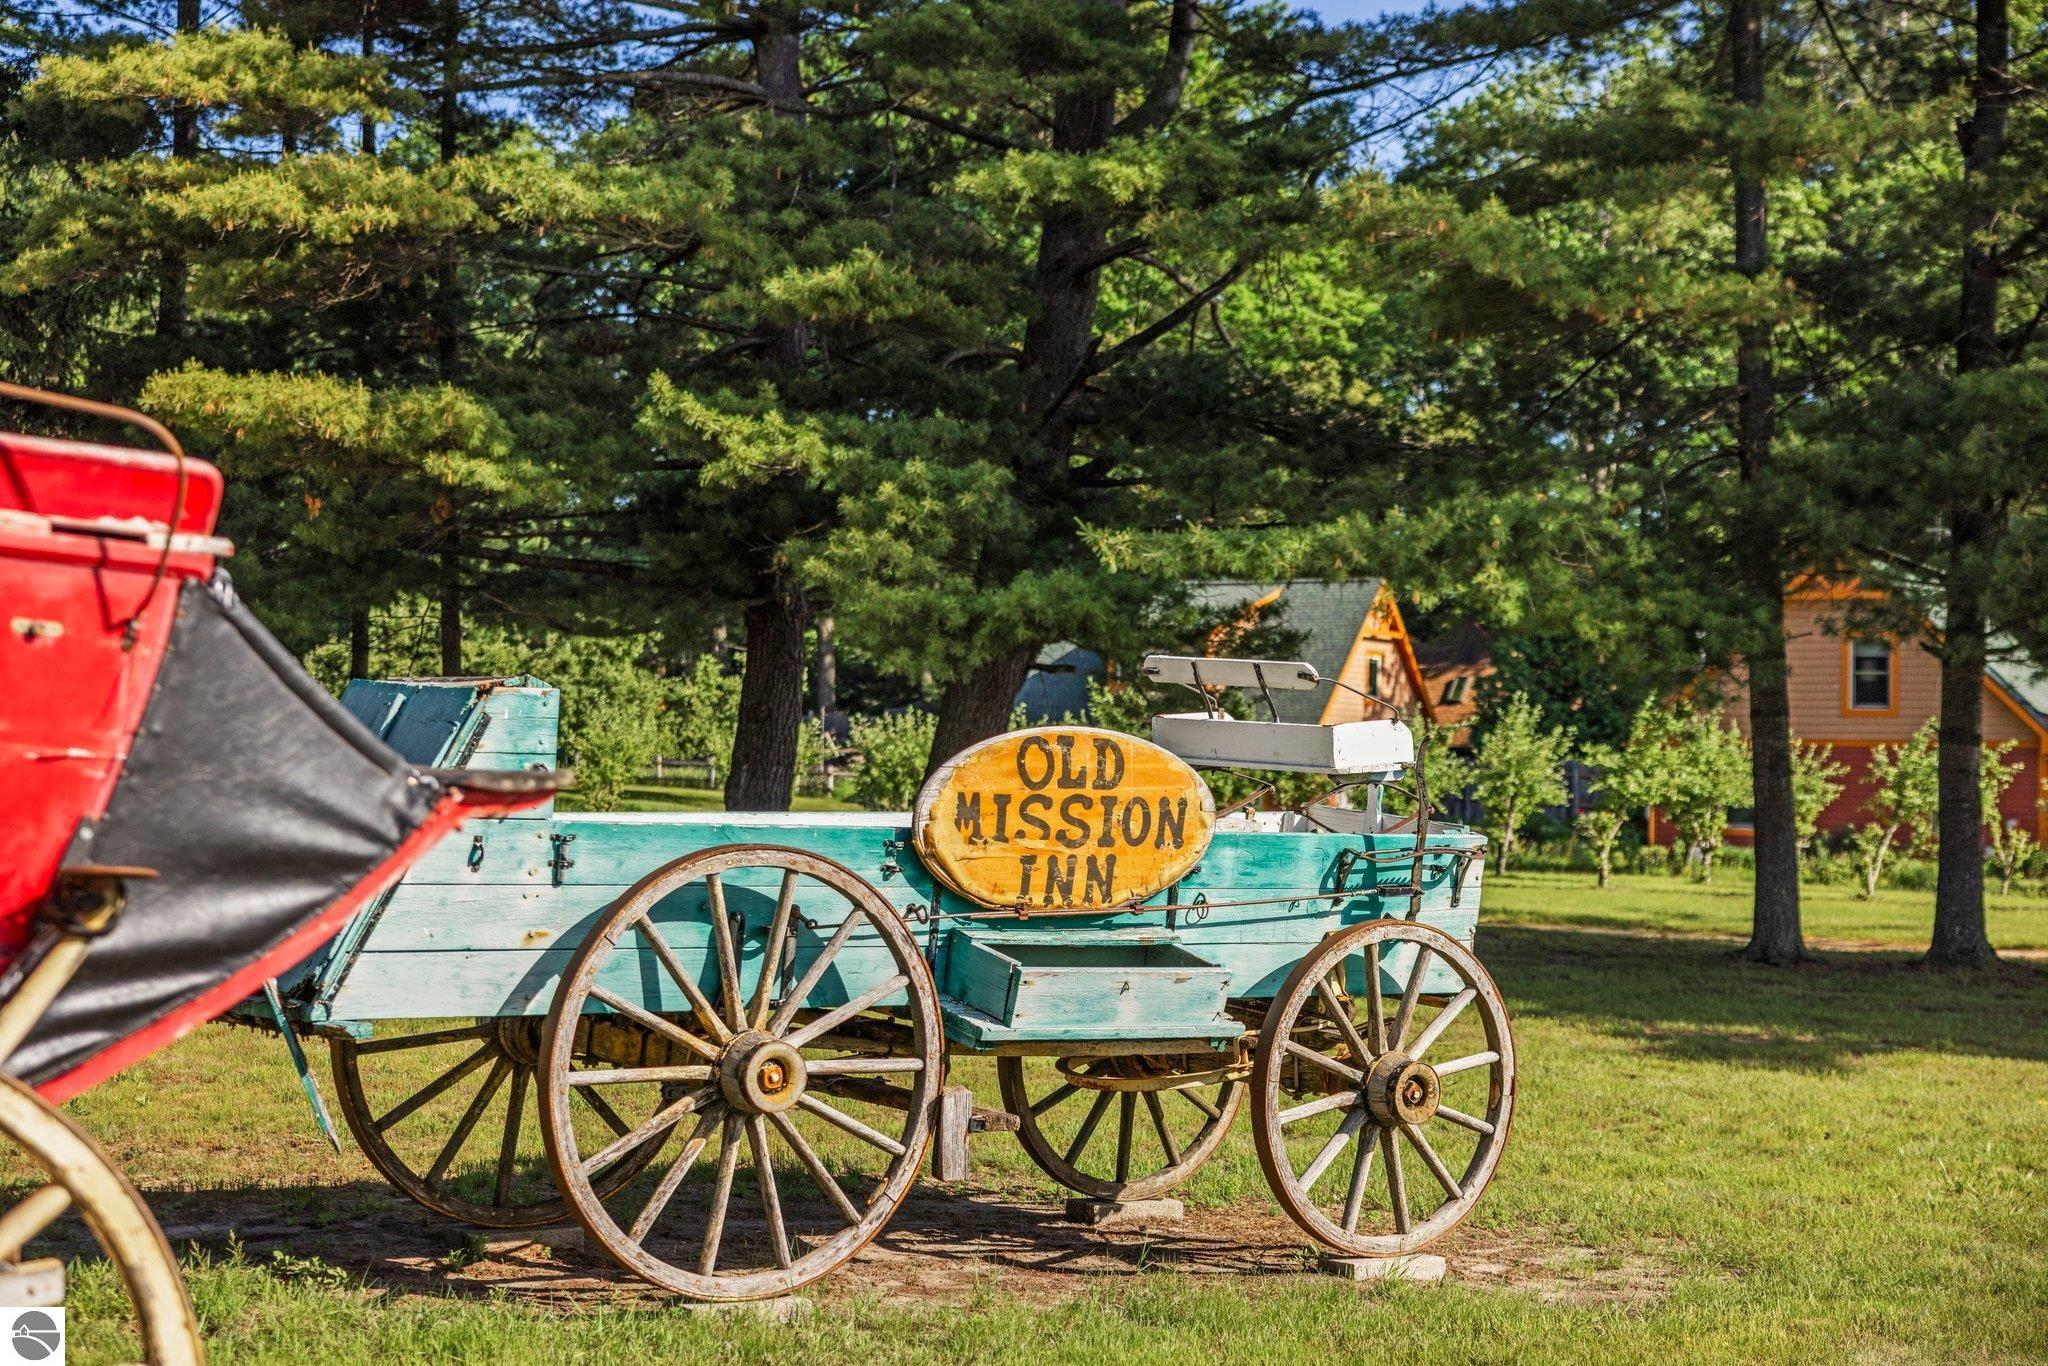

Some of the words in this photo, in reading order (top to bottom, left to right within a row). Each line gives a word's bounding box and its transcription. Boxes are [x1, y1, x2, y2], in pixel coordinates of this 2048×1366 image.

[1017, 735, 1125, 790] OLD
[954, 792, 1188, 849] MISSION
[1016, 854, 1117, 908] INN
